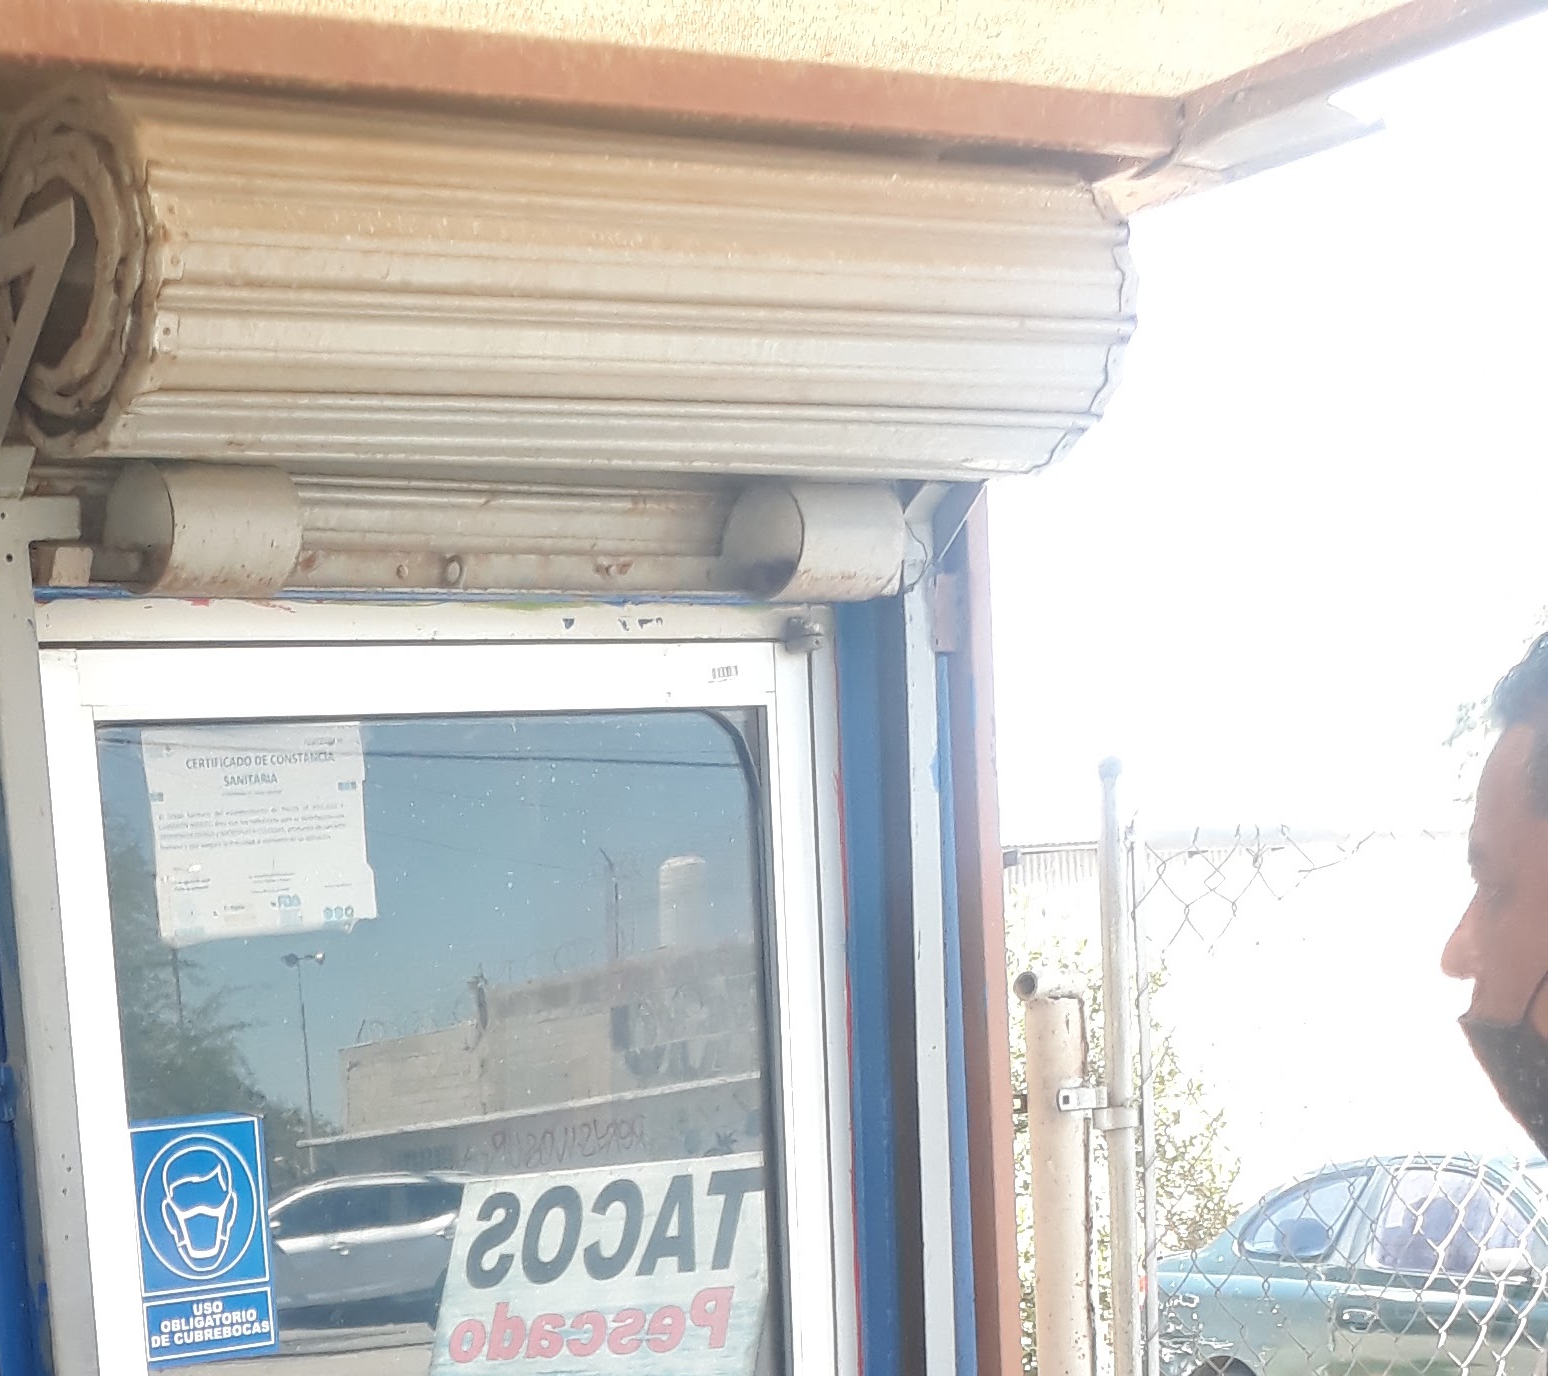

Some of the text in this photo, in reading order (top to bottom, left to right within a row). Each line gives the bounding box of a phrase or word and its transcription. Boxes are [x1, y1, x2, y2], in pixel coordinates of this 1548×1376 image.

[185, 751, 335, 770] CERTIFICADO DE CONSTANCIA
[223, 773, 278, 787] SANITARIA
[193, 1301, 223, 1316] USO
[160, 1309, 257, 1333] OBLIGATORIO
[151, 1322, 270, 1348] DE CUBREBOCAS
